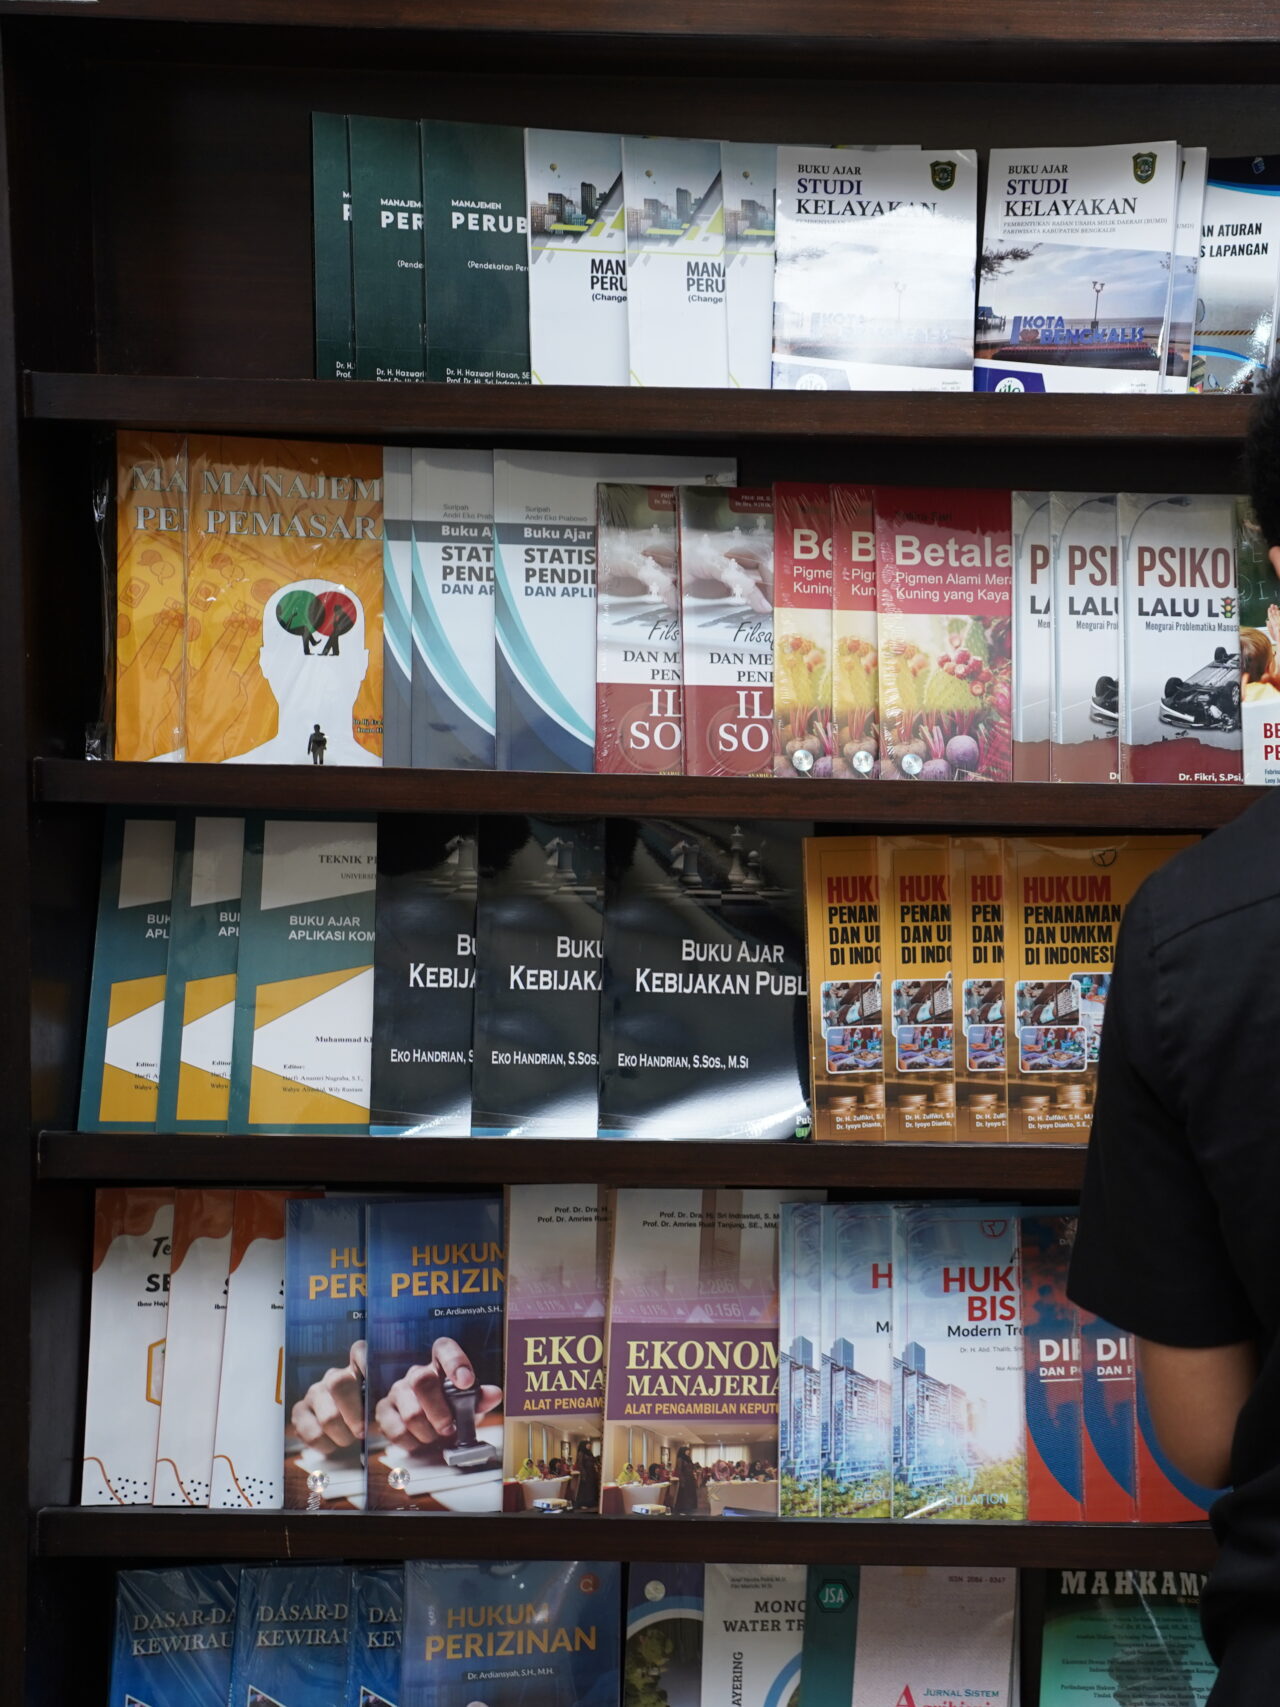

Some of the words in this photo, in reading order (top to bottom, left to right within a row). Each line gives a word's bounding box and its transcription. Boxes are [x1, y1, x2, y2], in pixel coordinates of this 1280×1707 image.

[798, 164, 830, 175] BUKU
[833, 165, 862, 175] AJAR
[1008, 165, 1038, 175] BUKU
[1041, 164, 1069, 174] AJAR
[797, 178, 863, 195] STUDI
[1006, 178, 1070, 195] STUDI
[451, 199, 502, 210] MANAJEMEN
[1003, 197, 1138, 217] KELAYAKAN
[451, 212, 528, 234] PERUB
[1218, 222, 1262, 238] ATURAN
[1209, 242, 1269, 258] LAPANGAN
[468, 260, 513, 271] (Pendekatan
[591, 258, 626, 275] MAN
[687, 278, 726, 293] PERU
[592, 293, 627, 303] (Change
[688, 294, 723, 304] (Change
[1022, 316, 1065, 329] KOTA
[202, 471, 383, 501] MANAJEM
[204, 510, 384, 540] PEMASAR
[441, 525, 478, 537] Buku
[523, 527, 560, 539] Buku
[563, 528, 593, 543] Ajar
[441, 545, 494, 562] STAT
[524, 548, 596, 565] STATIS
[895, 534, 1012, 568] Betala
[1068, 545, 1118, 586] PSI
[895, 572, 943, 586] Pigmen
[946, 573, 981, 585] Alami
[524, 586, 556, 597] DAN
[896, 589, 940, 603] Kuning
[943, 590, 974, 603] yang
[977, 589, 1009, 603] Kaya
[1138, 597, 1199, 618] LALU
[1076, 619, 1105, 632] Mengurai
[1145, 621, 1175, 632] Mengurai
[1175, 621, 1216, 632] Problematika
[623, 650, 658, 663] DAN
[709, 652, 744, 665] DAN
[649, 689, 683, 717] IL
[736, 690, 773, 719] IL
[630, 721, 681, 750] SO
[718, 723, 769, 752] SO
[1178, 773, 1192, 782] Dr.
[1194, 773, 1216, 783] Fikri,
[318, 854, 363, 865] TEKNIK
[1023, 876, 1112, 903] HUKUM
[289, 915, 325, 926] BUKU
[327, 916, 360, 927] AJAR
[1024, 904, 1121, 925] PENANAMAN
[288, 930, 346, 941] APLIKASI
[348, 931, 376, 942] KOM
[1024, 926, 1057, 945] DAN
[1060, 925, 1113, 944] UMKM
[1025, 947, 1042, 966] DI
[1044, 945, 1115, 965] INDONESI
[446, 1306, 487, 1317] Ardiansyah,
[704, 1303, 741, 1317] 0.156
[947, 1324, 1001, 1338] Modern
[524, 1334, 603, 1366] EKO
[625, 1340, 779, 1370] EKONOM
[1039, 1366, 1065, 1377] DAN
[1097, 1366, 1122, 1376] DAN
[524, 1399, 551, 1411] ALAT
[625, 1403, 651, 1415] ALAT
[655, 1403, 737, 1415] PENGAMBILAN
[823, 1587, 845, 1603] JSA
[259, 1604, 348, 1622] DASAR-D
[447, 1603, 549, 1628] HUKUM
[723, 1619, 781, 1633] WATER
[132, 1632, 233, 1656] KEWIRAU
[425, 1625, 597, 1661] PERIZINAN
[467, 1672, 479, 1680] Dr.
[479, 1669, 520, 1680] Ardiansyah,
[923, 1688, 962, 1697] JURNAL
[964, 1688, 999, 1697] SISTEM
